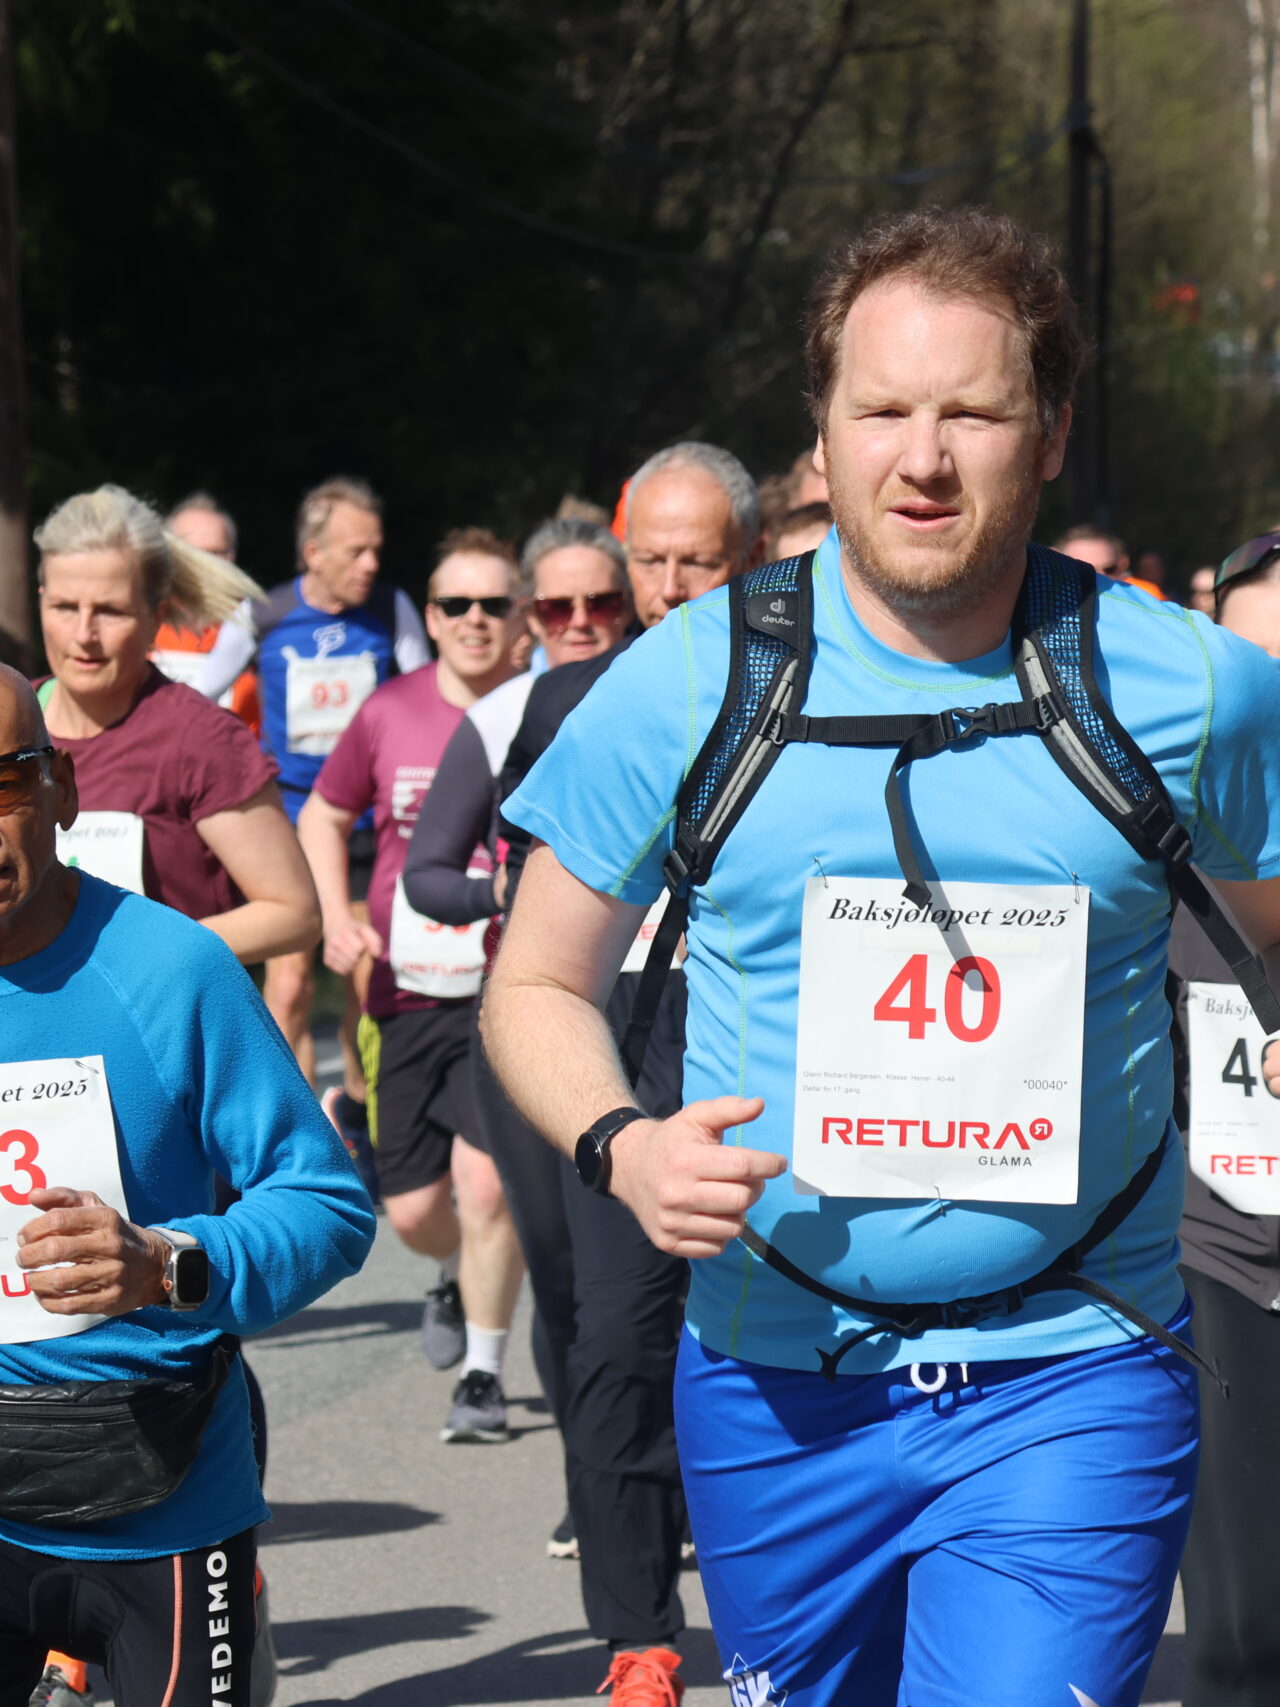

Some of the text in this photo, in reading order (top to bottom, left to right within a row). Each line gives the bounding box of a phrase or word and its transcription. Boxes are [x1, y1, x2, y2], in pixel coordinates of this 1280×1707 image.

[762, 614, 795, 627] deuter
[311, 681, 349, 711] 93
[827, 898, 1070, 931] Baksjøløpet 2025
[874, 954, 1001, 1042] 40
[32, 1079, 87, 1101] 2025
[821, 1117, 1030, 1150] RETURA
[1210, 1155, 1280, 1176] RET
